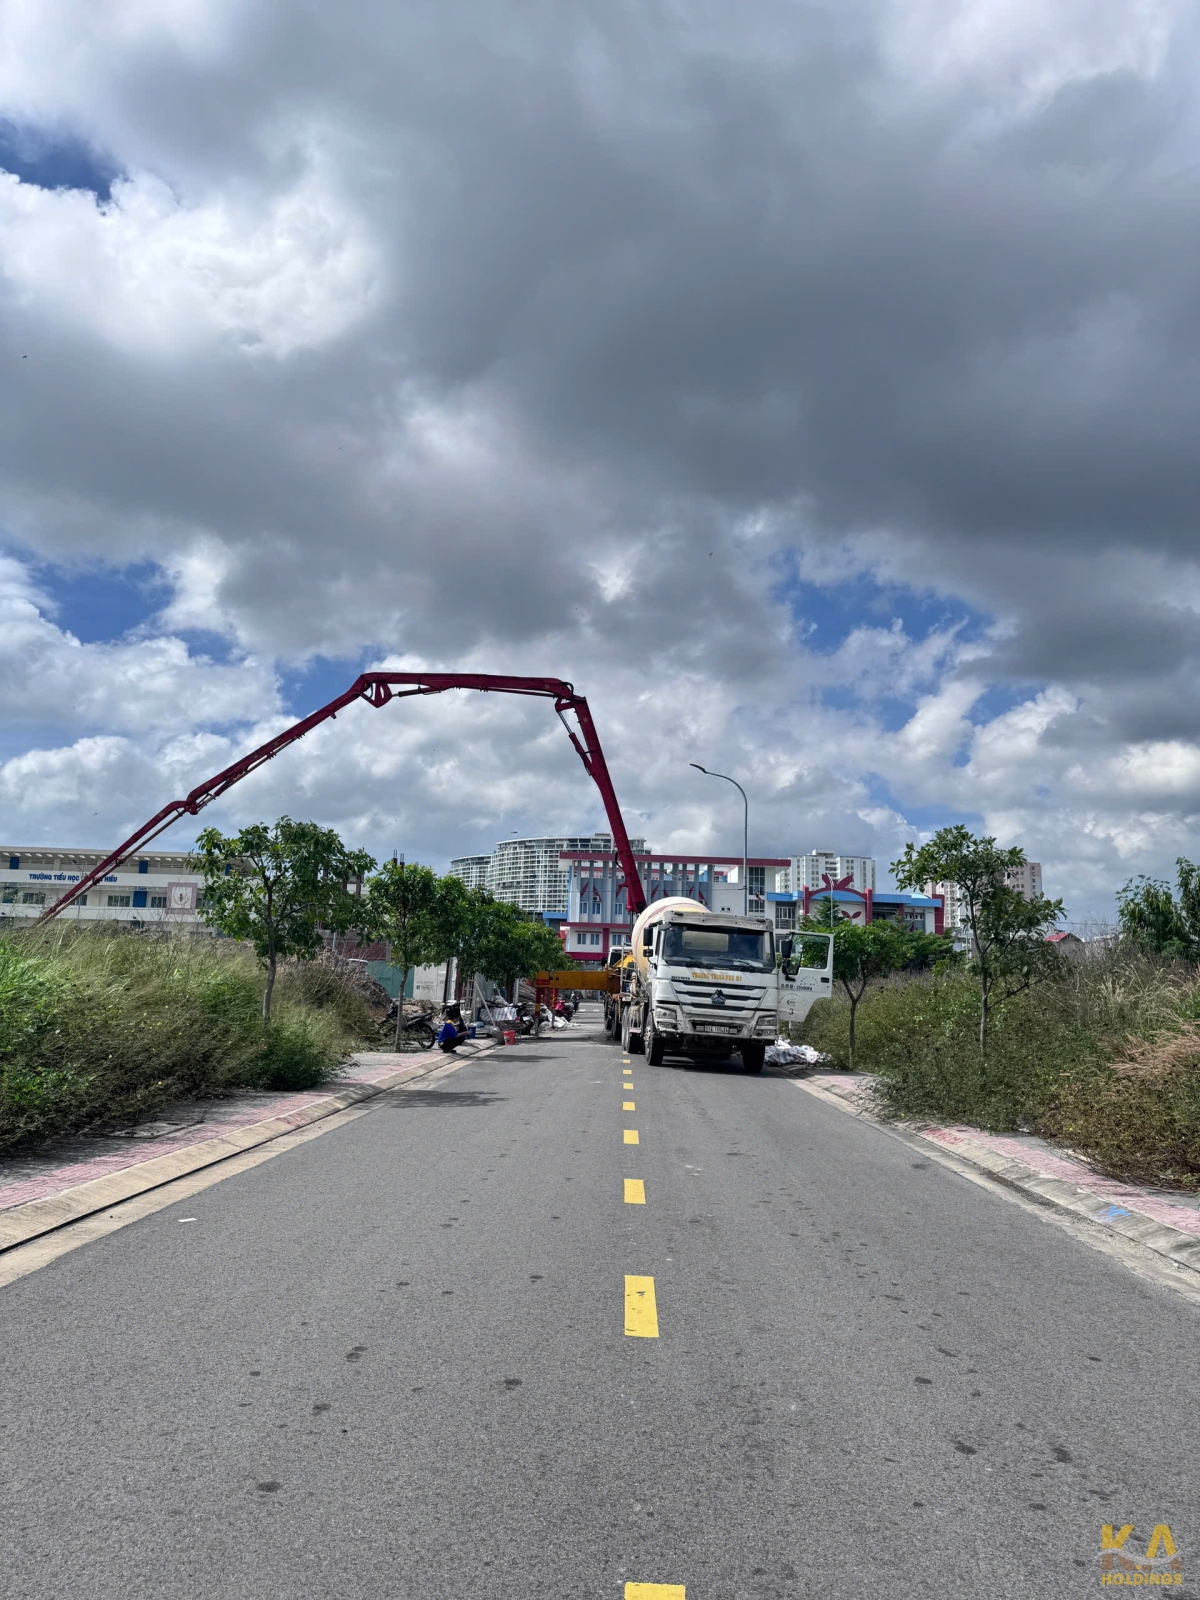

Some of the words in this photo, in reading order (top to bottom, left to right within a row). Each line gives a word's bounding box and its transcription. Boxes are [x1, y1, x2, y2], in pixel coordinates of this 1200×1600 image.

[29, 872, 52, 880] TRƯỜNG
[53, 872, 66, 881] TIỂU
[67, 874, 80, 882] HỌC
